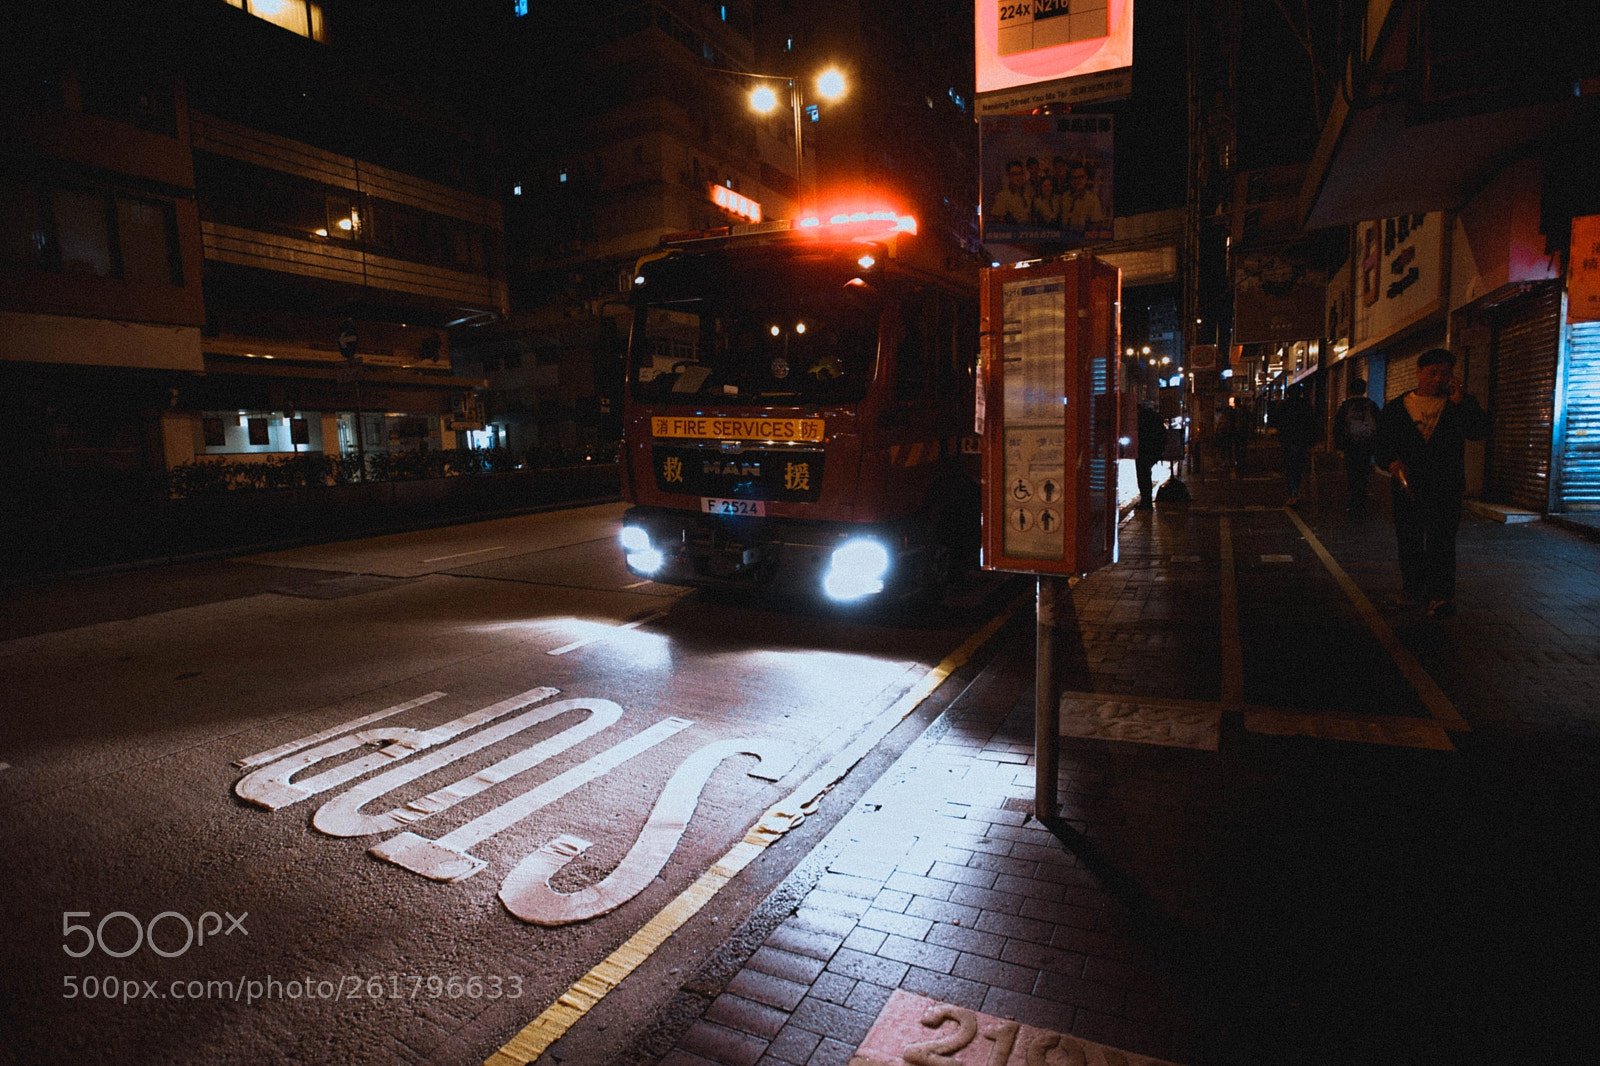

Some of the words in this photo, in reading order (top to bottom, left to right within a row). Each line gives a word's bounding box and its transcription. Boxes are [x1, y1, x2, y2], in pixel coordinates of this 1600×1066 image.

[656, 418, 669, 436] 消
[674, 420, 707, 436] FIRE
[713, 420, 795, 438] SERVICES
[801, 421, 818, 439] 防
[663, 456, 683, 483] 救
[784, 462, 810, 491] 援
[703, 460, 761, 476] MAN
[708, 500, 716, 512] F
[722, 500, 758, 515] 2524
